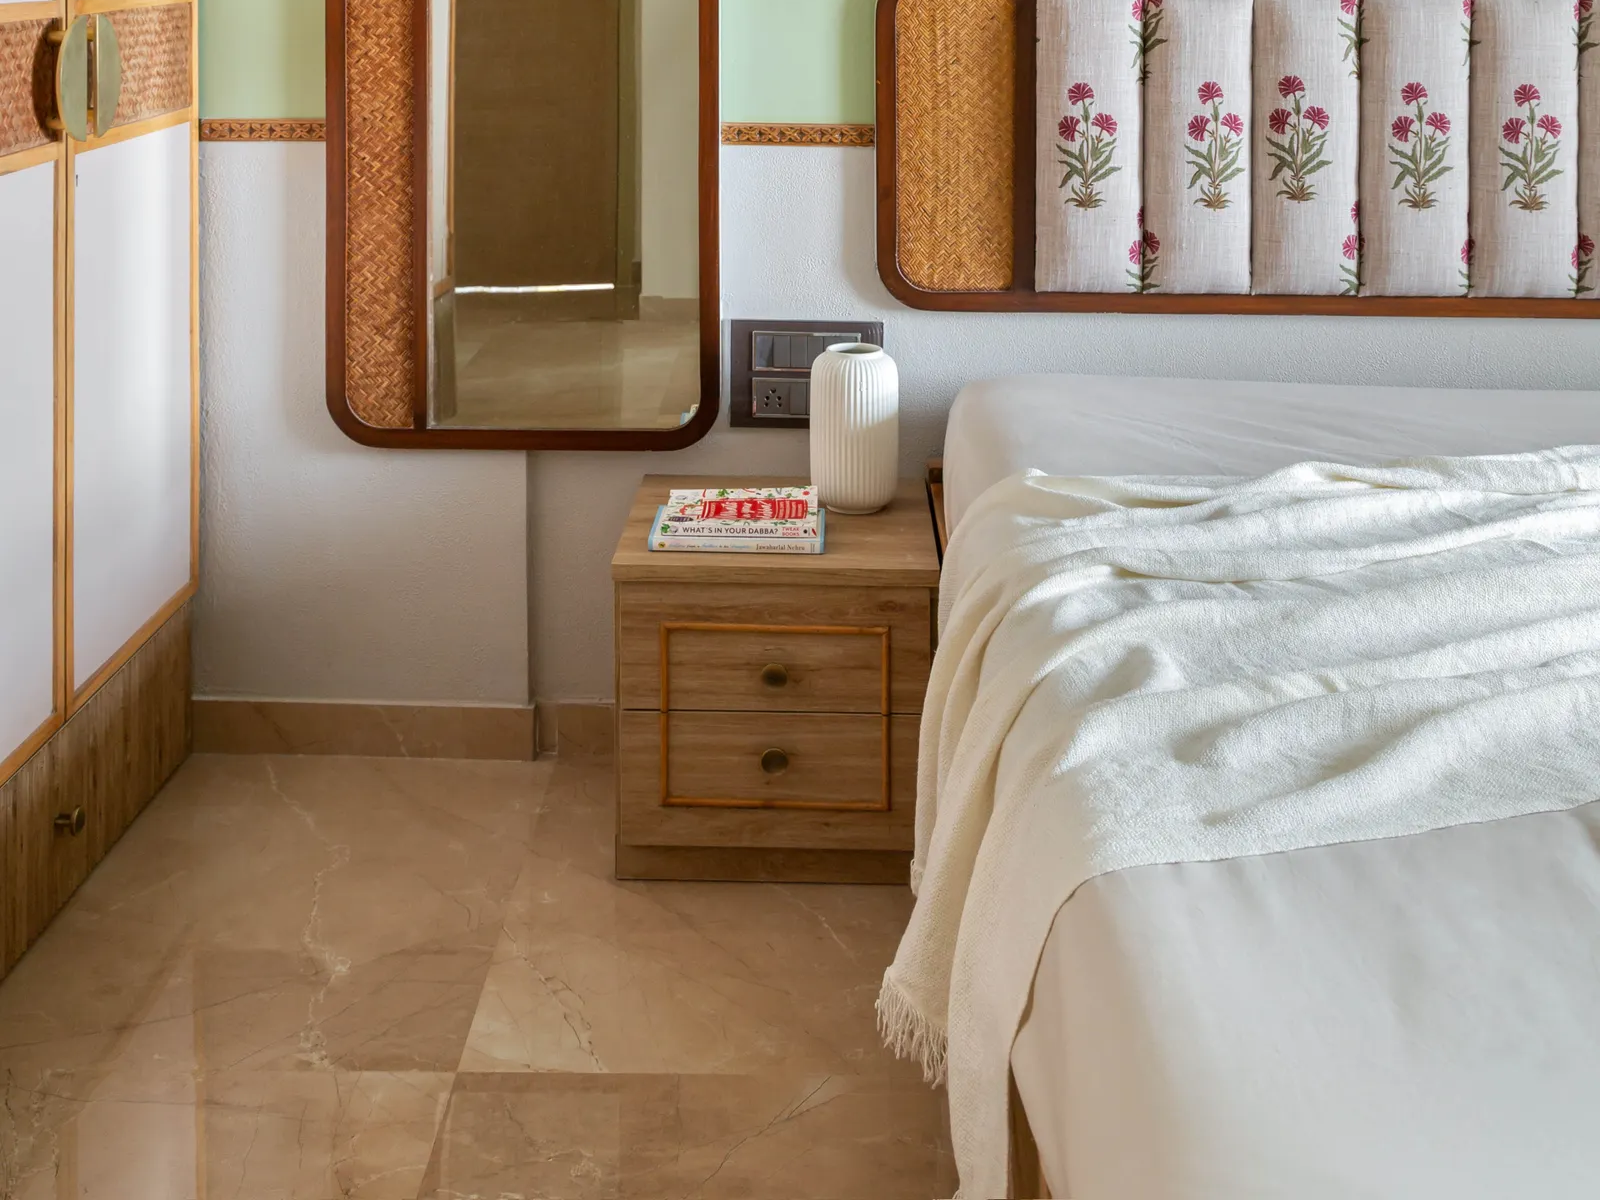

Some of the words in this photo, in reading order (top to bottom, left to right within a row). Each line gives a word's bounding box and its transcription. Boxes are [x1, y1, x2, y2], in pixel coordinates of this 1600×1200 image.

[682, 526, 713, 534] WHAT'S
[748, 527, 779, 535] DABBA?
[755, 543, 786, 551] Jawaharlal
